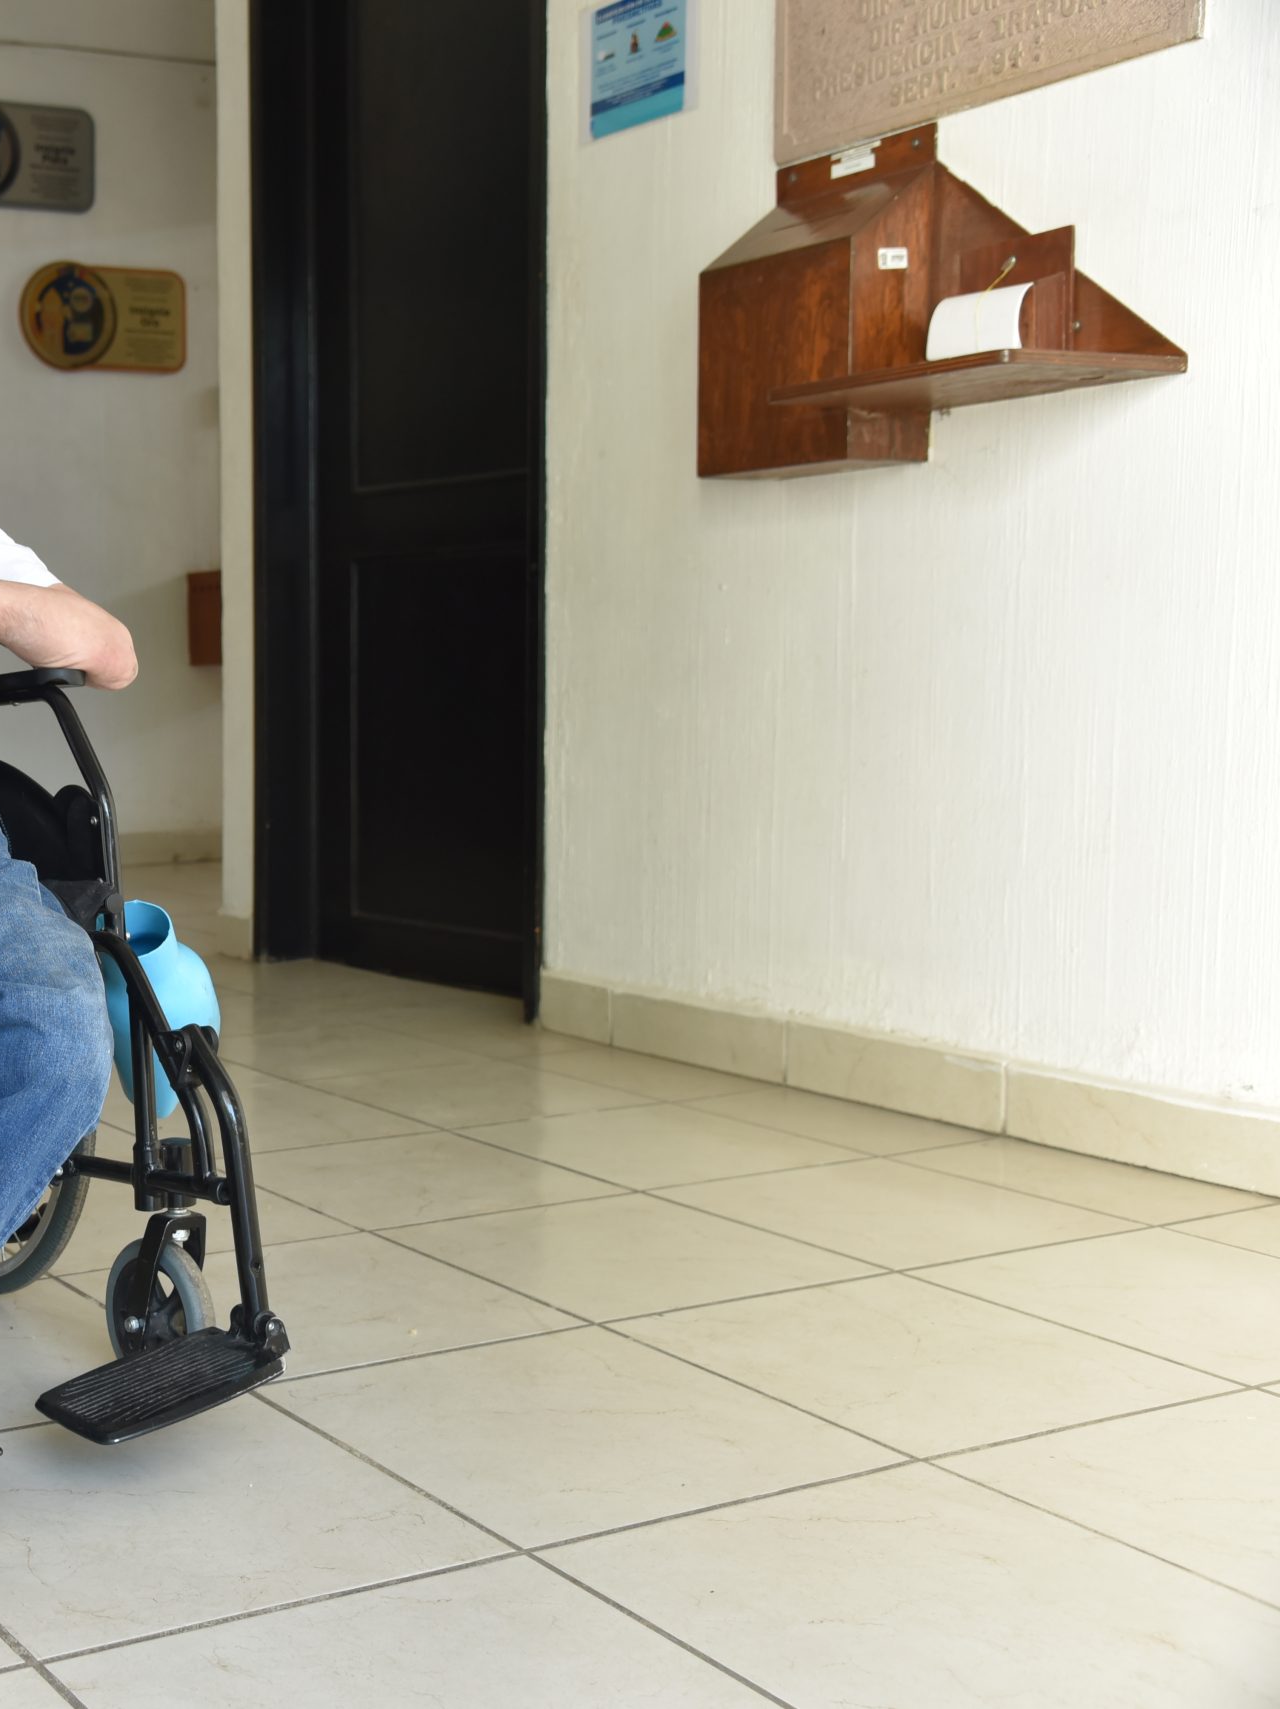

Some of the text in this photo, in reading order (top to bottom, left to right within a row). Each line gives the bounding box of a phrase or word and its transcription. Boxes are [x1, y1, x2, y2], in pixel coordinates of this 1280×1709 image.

[812, 30, 961, 102] PRESIDENCIA
[990, 0, 1108, 43] IRAPU
[869, 15, 906, 52] DIF
